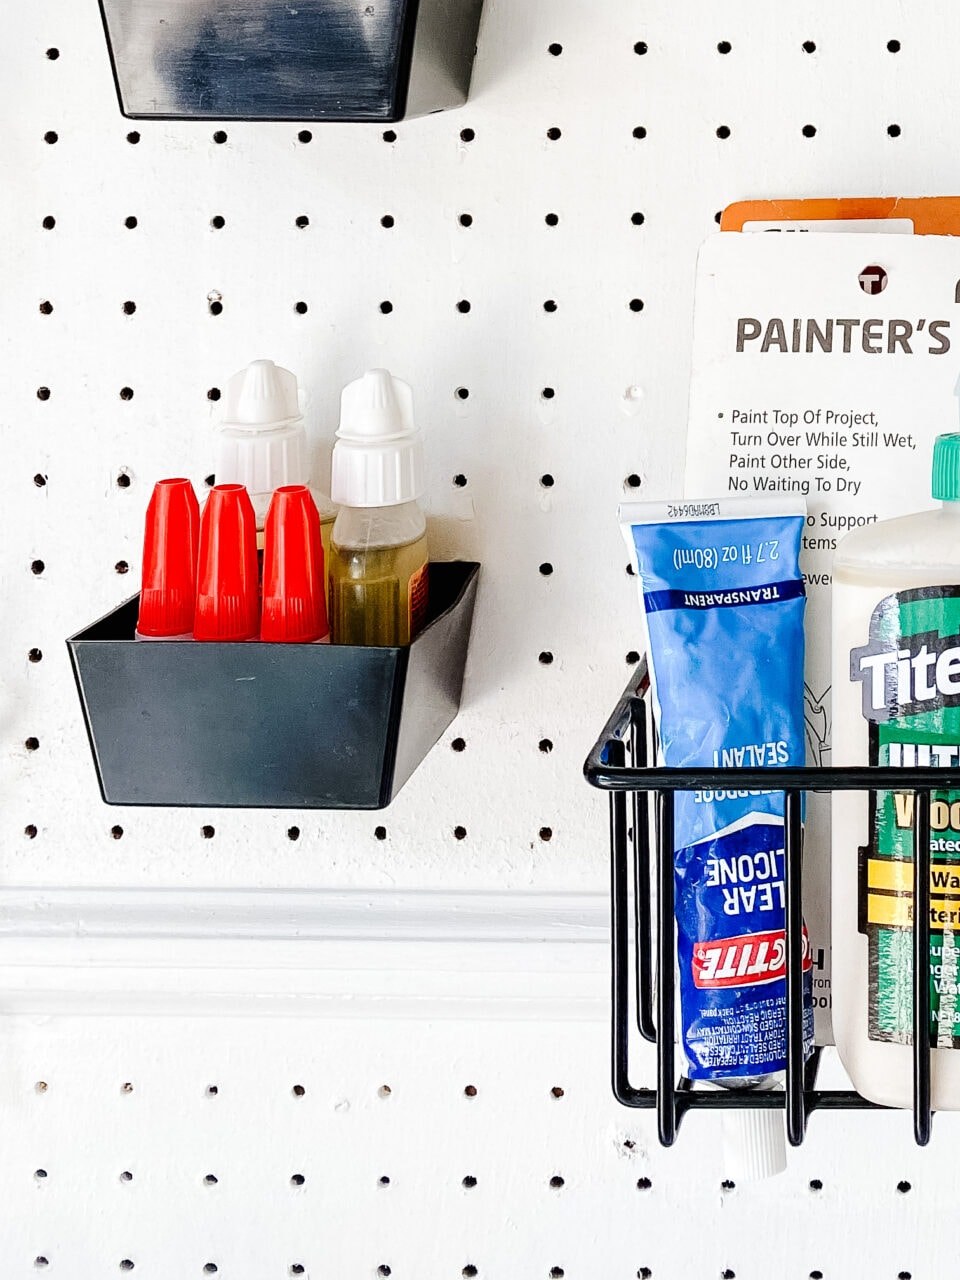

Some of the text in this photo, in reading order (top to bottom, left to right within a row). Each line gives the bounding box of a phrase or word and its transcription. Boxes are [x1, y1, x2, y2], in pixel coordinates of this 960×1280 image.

[735, 317, 951, 355] PAINTER'S
[731, 409, 879, 428] Paint Top Of Project,
[730, 431, 917, 450] Turn Over While Still Wet,
[729, 454, 850, 471] Paint Other Side,
[728, 477, 861, 495] No Waiting To Dry
[673, 540, 780, 570] 2.7 fl oz (80ml)
[684, 586, 780, 607] TRANSPARENT
[723, 880, 785, 916] LEAR
